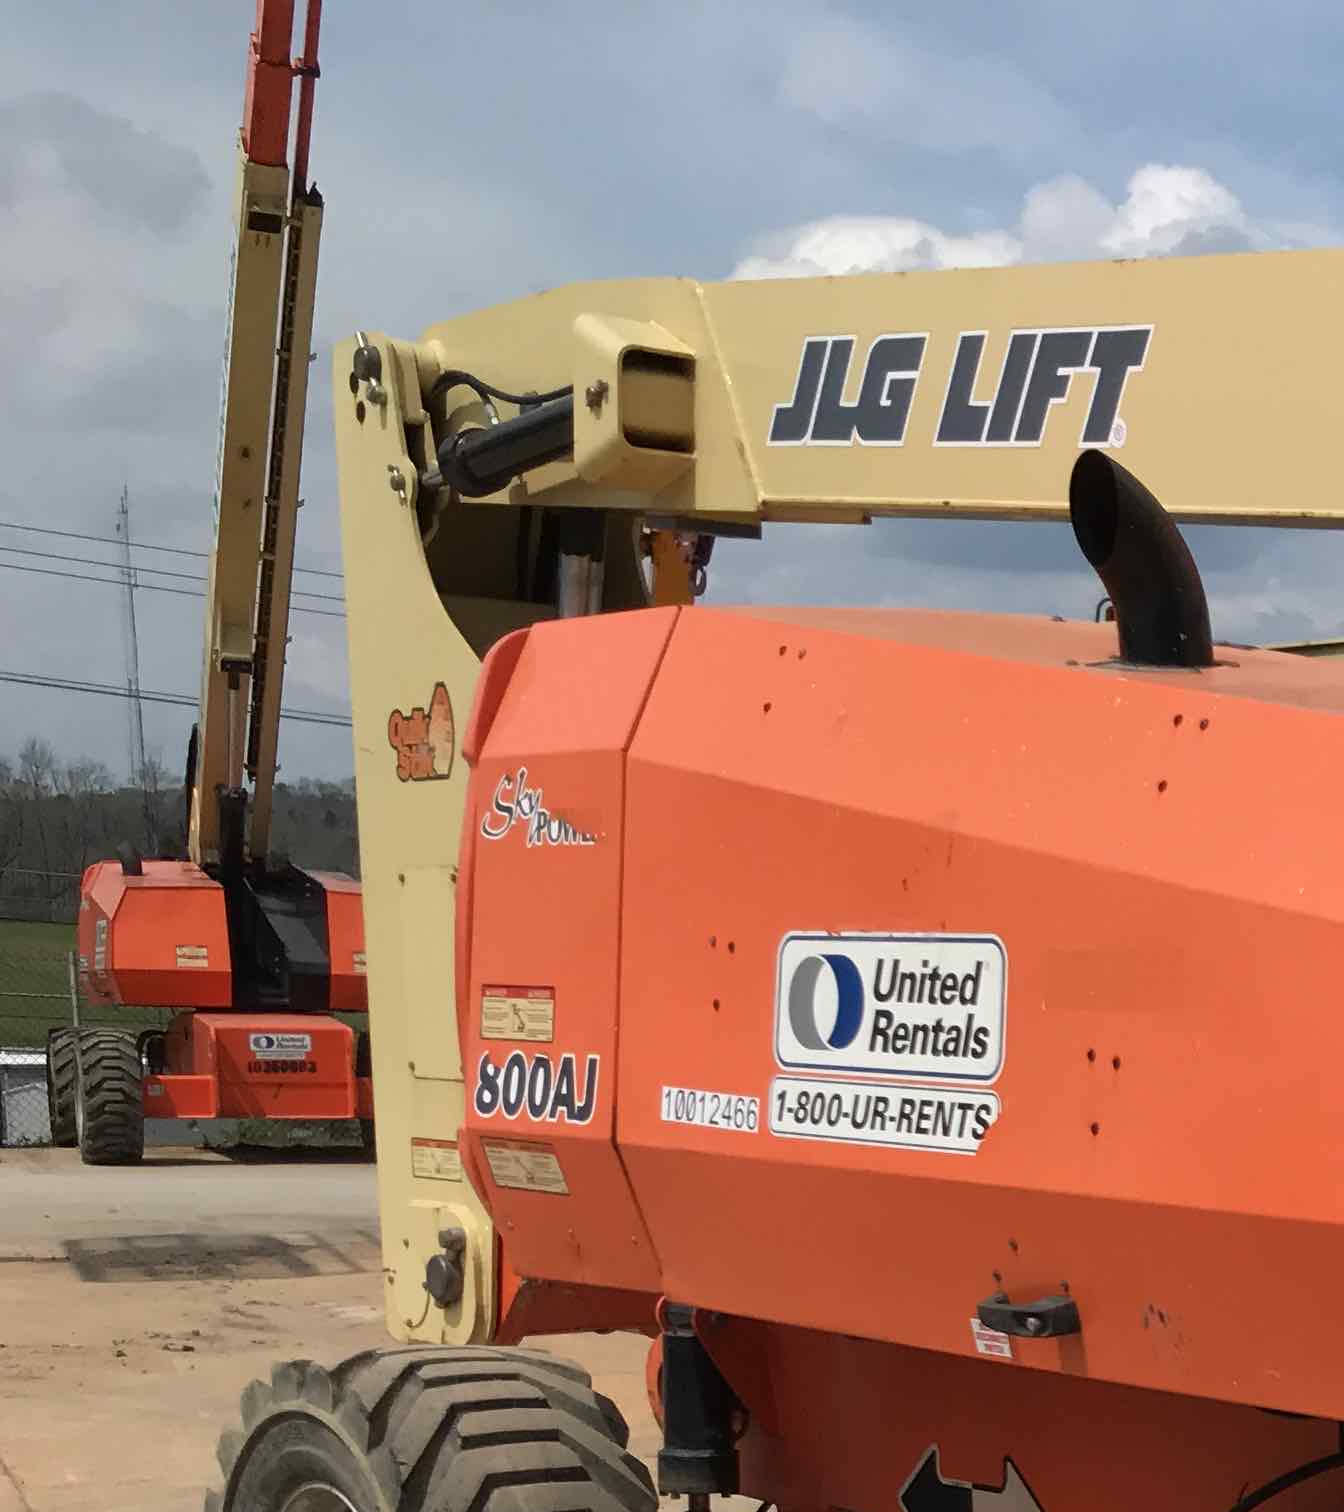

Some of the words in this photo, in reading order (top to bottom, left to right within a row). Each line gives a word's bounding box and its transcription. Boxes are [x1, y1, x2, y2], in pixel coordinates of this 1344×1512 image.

[766, 332, 931, 447] JLG
[931, 323, 1156, 447] LIFT
[873, 957, 983, 1006] United
[868, 1008, 991, 1060] Rentals
[473, 1049, 600, 1126] 800AJ
[664, 1088, 759, 1131] 10012466
[776, 1089, 993, 1141] 1-800-UR-RENTS
